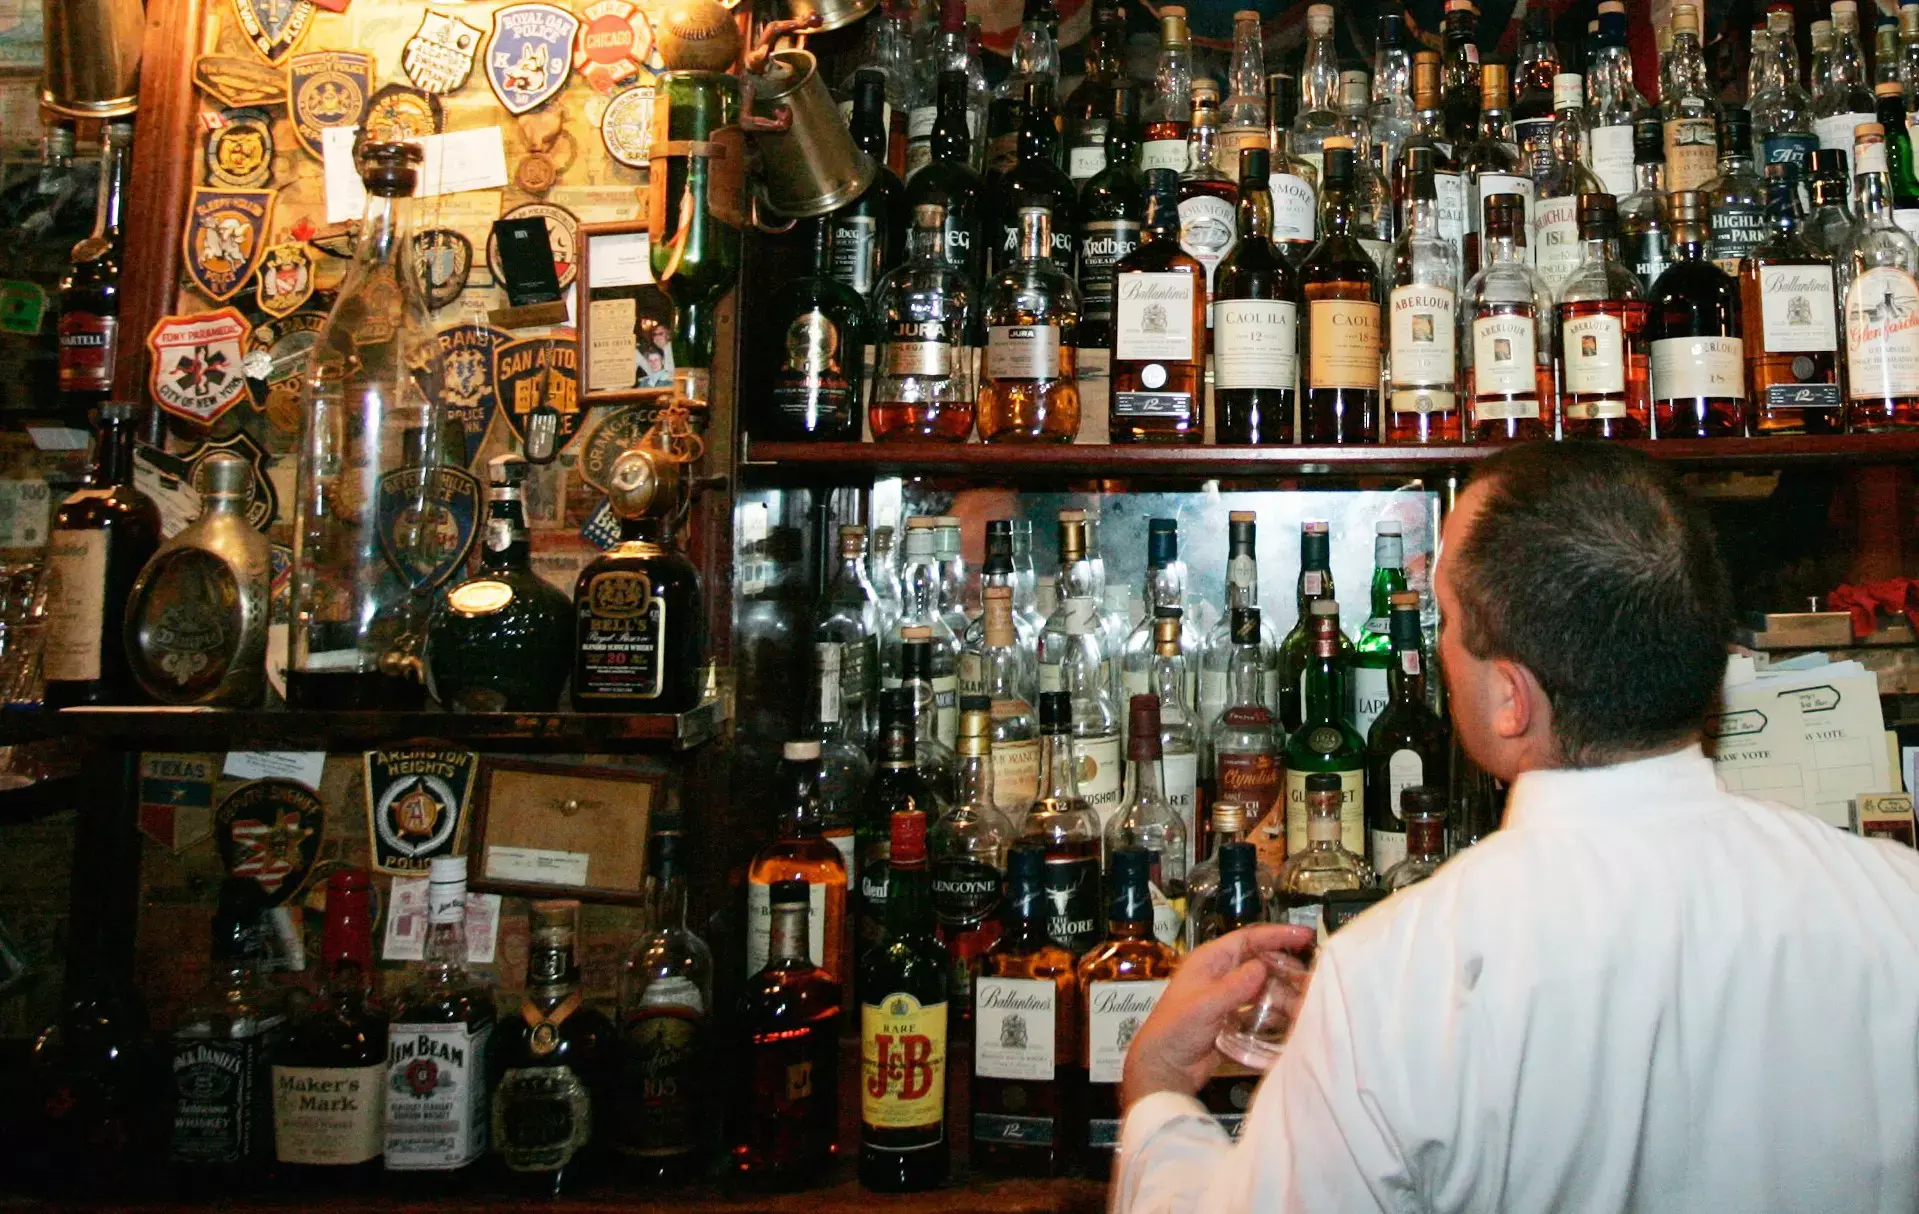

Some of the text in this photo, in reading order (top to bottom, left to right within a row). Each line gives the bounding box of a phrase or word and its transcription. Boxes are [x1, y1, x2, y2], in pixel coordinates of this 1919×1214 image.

[502, 13, 572, 37] ROYAL OAK
[513, 25, 560, 45] POLICE
[587, 31, 631, 49] CHICAGO
[493, 52, 565, 75] K 9
[1120, 279, 1190, 301] Ballantine's
[1765, 272, 1831, 295] Ballantine's
[1395, 296, 1450, 312] ABERLOUR
[1226, 311, 1287, 325] CAOL ILA
[1332, 313, 1370, 327] CAOL
[187, 324, 240, 341] PARAMEDIC
[893, 324, 947, 338] JURA
[1008, 329, 1035, 339] JURA
[1480, 324, 1527, 340] ABERLOUR
[1569, 320, 1612, 335] ABERLOUR
[501, 350, 532, 380] SAN
[1142, 397, 1164, 411] 12
[1815, 729, 1847, 741] VOTE
[1742, 750, 1772, 762] VOTE
[150, 760, 205, 777] TEXAS
[386, 761, 456, 777] HEIGHTS
[981, 987, 1053, 1010] Ballantine's
[883, 1024, 917, 1034] RARE
[387, 1034, 464, 1069] JIM BEAM
[866, 1033, 934, 1101] J&B
[279, 1075, 361, 1093] Maker's
[298, 1094, 358, 1112] Mark
[1001, 1123, 1025, 1138] 12
